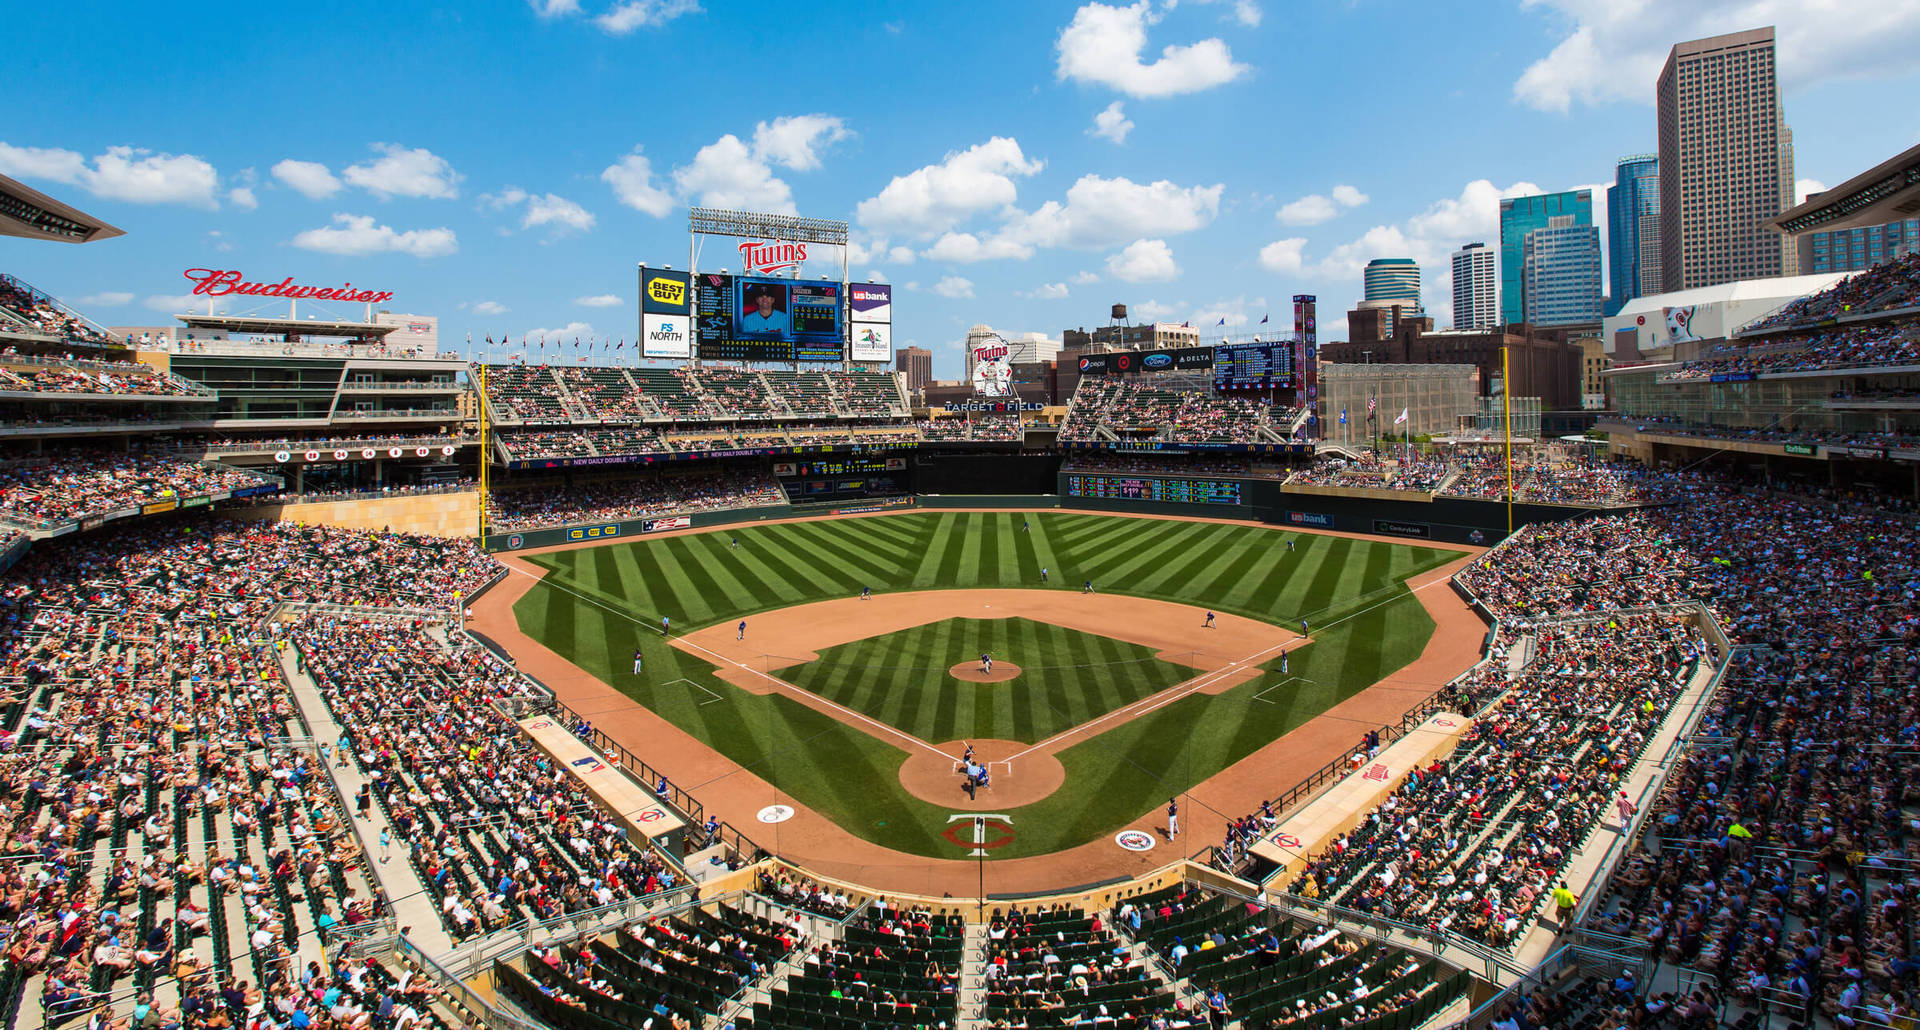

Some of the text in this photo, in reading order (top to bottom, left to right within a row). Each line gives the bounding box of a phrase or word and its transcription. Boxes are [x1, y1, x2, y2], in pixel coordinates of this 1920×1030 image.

[738, 238, 808, 270] Twins
[184, 268, 394, 303] Budweiser
[653, 281, 684, 294] BEST
[654, 290, 680, 300] BUY
[660, 323, 674, 332] FS
[650, 331, 682, 342] NORTH
[974, 345, 1008, 362] Twins
[1148, 357, 1165, 365] Ford
[944, 402, 1044, 412] TARGET FIELD
